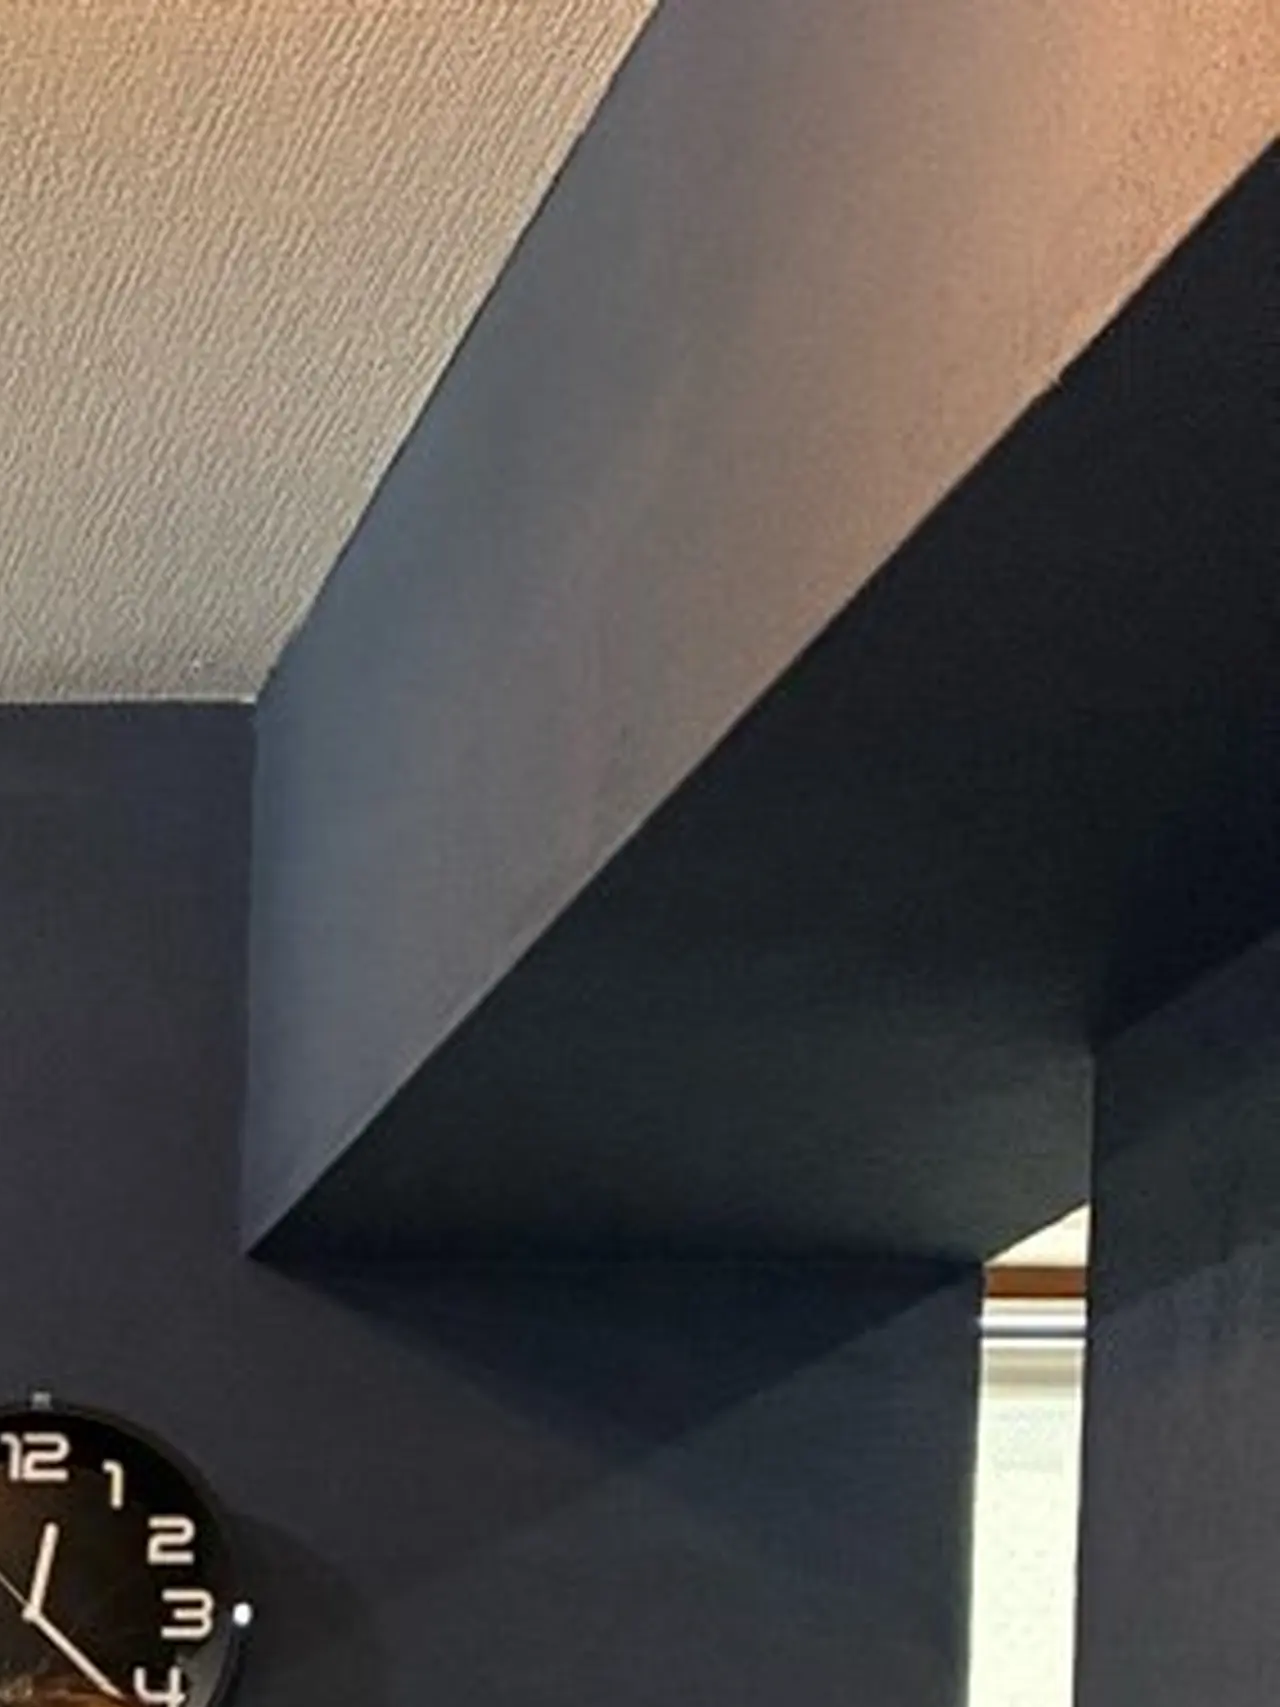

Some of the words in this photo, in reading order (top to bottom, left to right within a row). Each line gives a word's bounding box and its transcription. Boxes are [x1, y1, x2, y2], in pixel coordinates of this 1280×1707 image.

[0, 1432, 71, 1482] 12
[102, 1460, 124, 1509] 1
[147, 1515, 196, 1566] 2
[160, 1588, 215, 1640] 3
